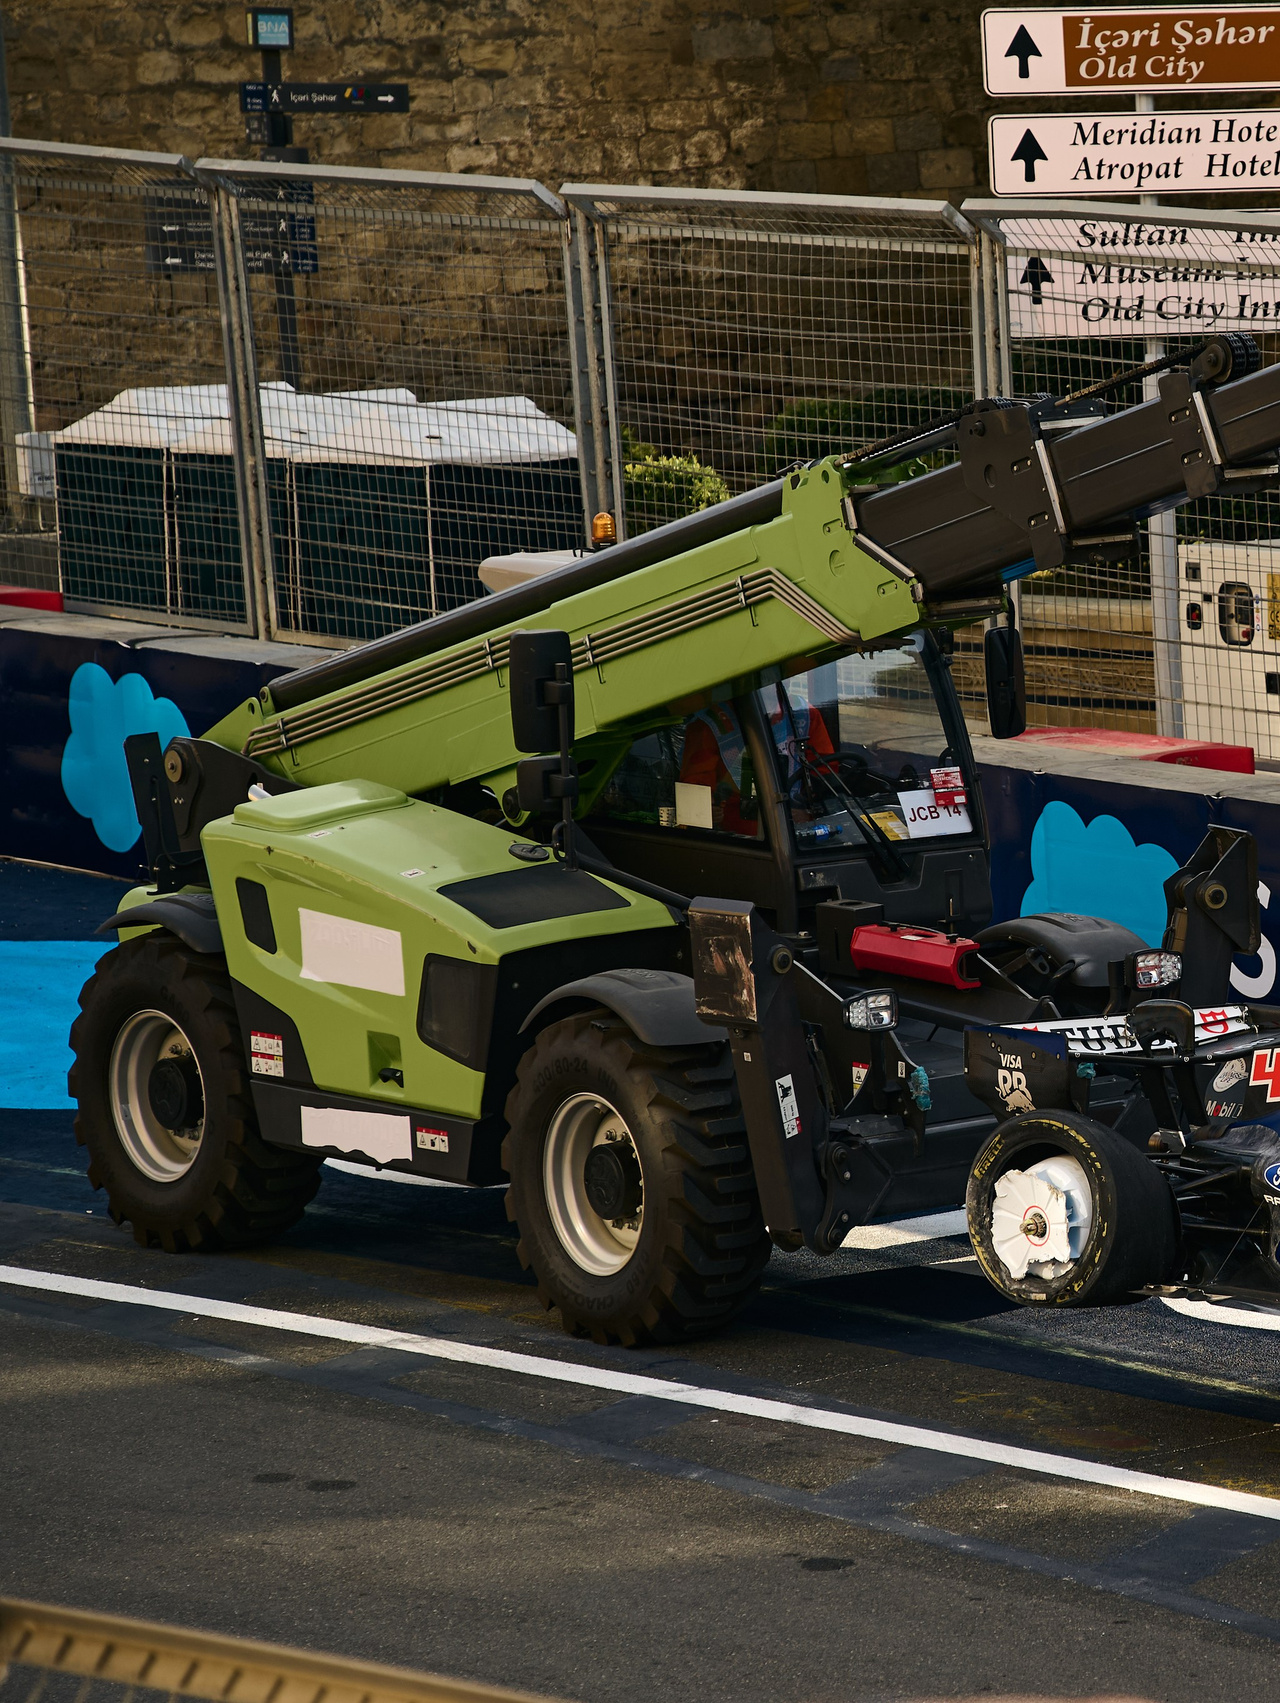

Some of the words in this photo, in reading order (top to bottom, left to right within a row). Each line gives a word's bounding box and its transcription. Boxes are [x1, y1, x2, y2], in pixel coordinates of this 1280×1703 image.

[258, 21, 288, 33] BNA
[1075, 17, 1160, 54] İçəri
[1171, 19, 1275, 53] Şəhər
[1078, 57, 1136, 79] Old
[1144, 56, 1205, 83] City
[1070, 119, 1201, 147] Meridian
[1070, 156, 1183, 188] Atropat
[1076, 222, 1189, 248] Sultan
[1081, 295, 1145, 322] Old
[1156, 294, 1225, 328] City
[909, 806, 940, 822] JCB
[943, 805, 961, 818] 14
[1001, 1053, 1023, 1070] VISA
[1206, 1100, 1234, 1117] Mobil
